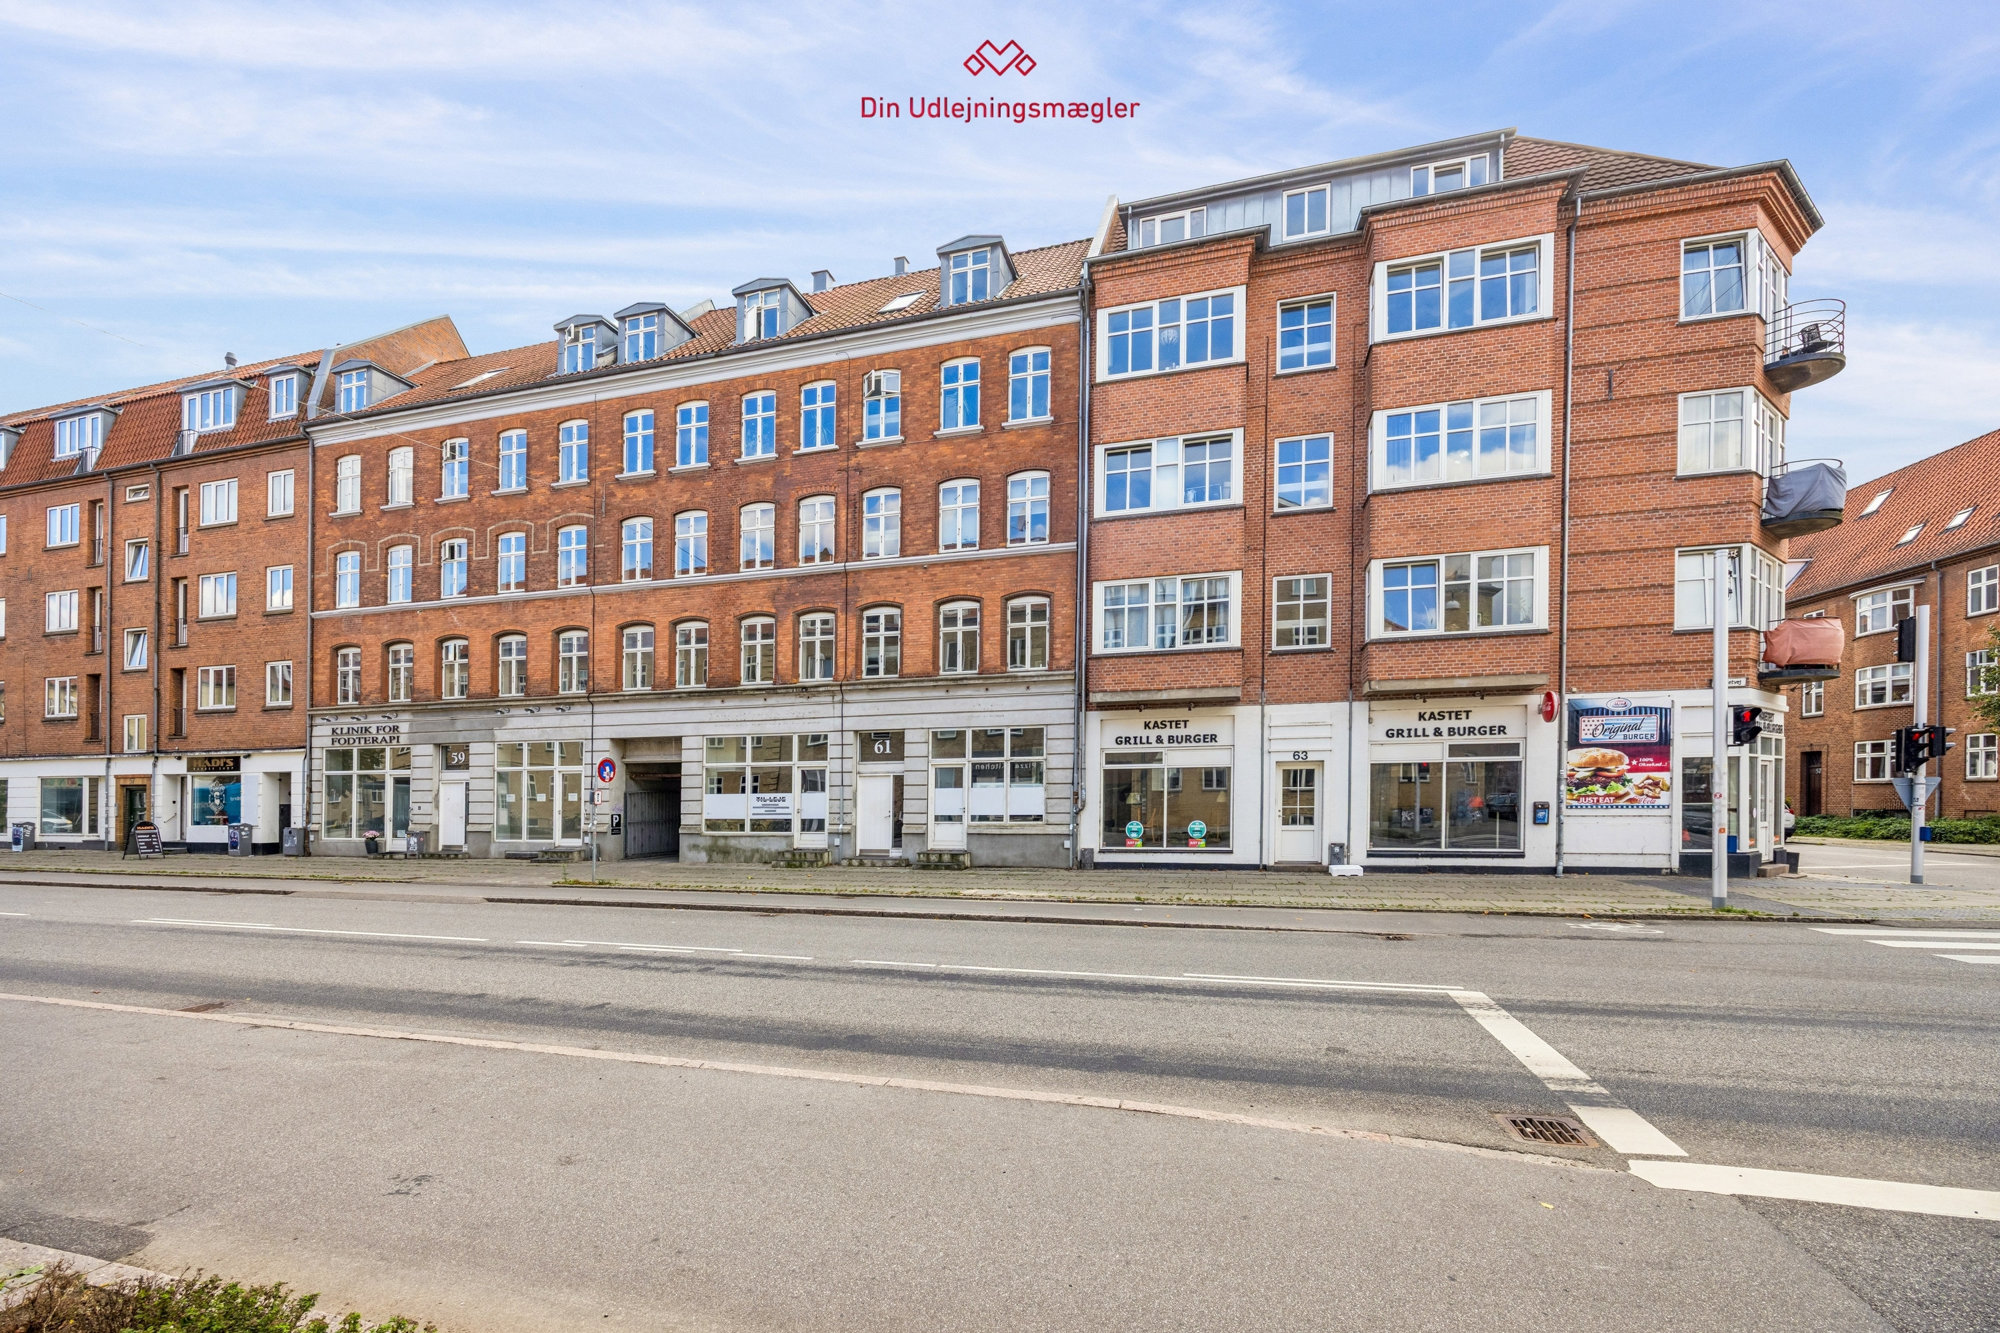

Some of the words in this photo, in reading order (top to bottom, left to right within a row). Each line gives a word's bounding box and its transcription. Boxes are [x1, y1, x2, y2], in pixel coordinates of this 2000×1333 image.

[1418, 709, 1472, 722] KASTET
[331, 725, 372, 736] KLINIK
[376, 725, 400, 734] FOR
[1143, 719, 1189, 730] KASTET
[1592, 717, 1645, 739] Original
[1385, 728, 1430, 739] GRILL
[1433, 727, 1443, 737] &
[1447, 725, 1508, 737] BURGER
[1622, 733, 1655, 741] BURGER
[331, 735, 400, 746] FODTERAPI
[1115, 735, 1152, 746] GRILL
[1155, 735, 1164, 745] &
[1167, 734, 1218, 745] BURGER
[874, 740, 892, 754] 61
[451, 752, 466, 764] 59
[1292, 751, 1309, 761] 63
[1578, 797, 1599, 805] JUST
[612, 815, 620, 827] P
